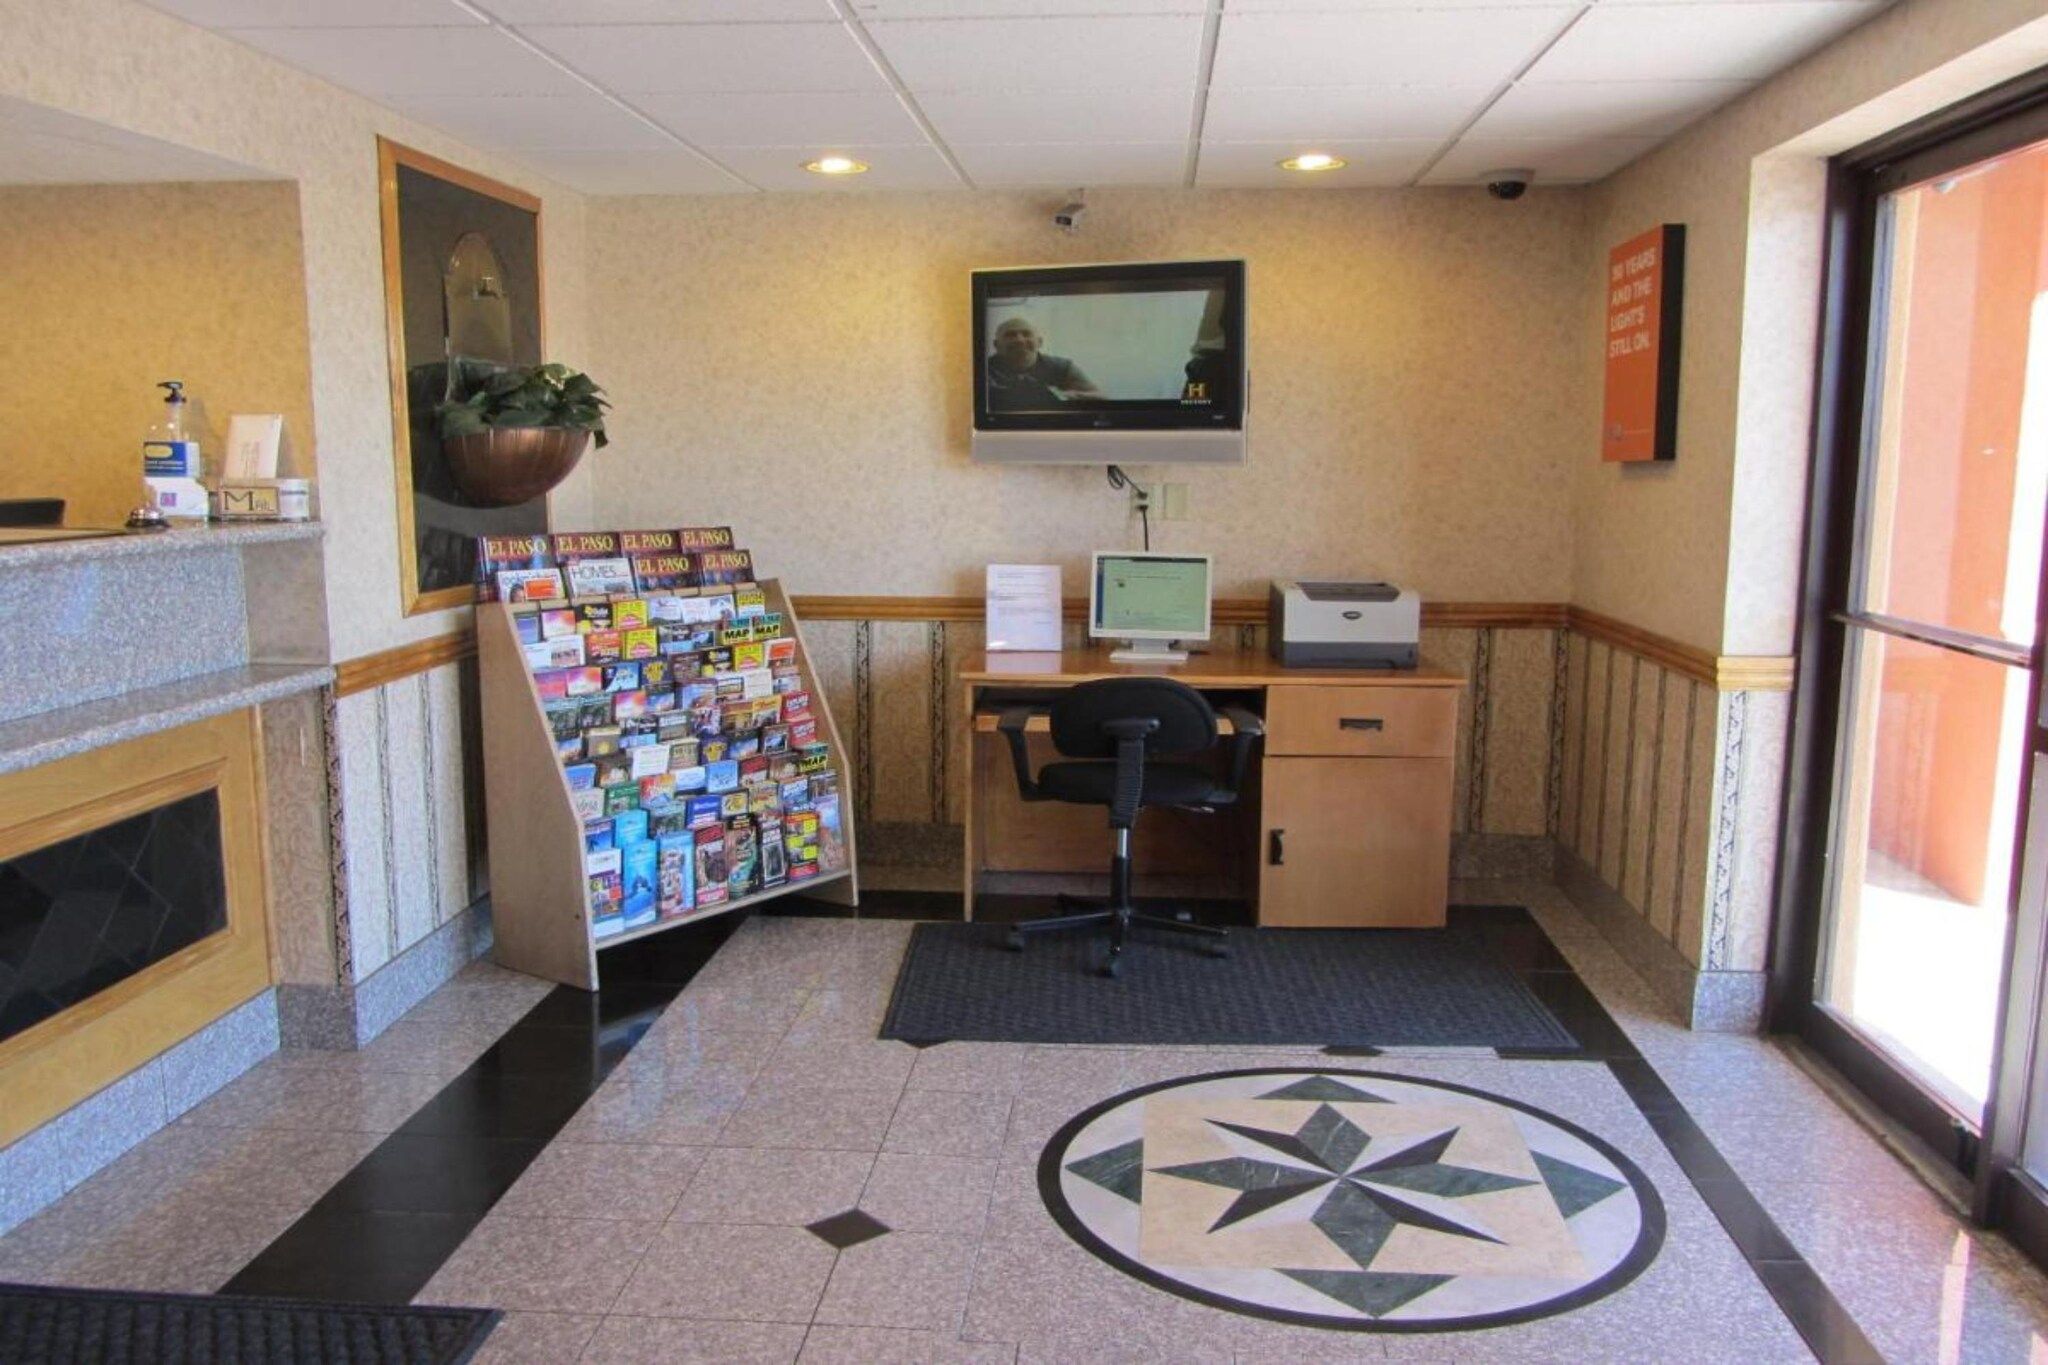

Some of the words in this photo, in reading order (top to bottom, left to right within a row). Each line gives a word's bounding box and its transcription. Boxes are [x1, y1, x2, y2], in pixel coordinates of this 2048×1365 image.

[1188, 383, 1206, 398] H
[559, 537, 577, 552] EL
[580, 535, 614, 552] PASO
[623, 534, 640, 549] EL
[642, 533, 672, 548] PASO
[682, 530, 698, 545] EL
[700, 529, 729, 545] PASO
[488, 540, 506, 556] EL
[509, 537, 547, 555] PASO
[637, 558, 659, 573] EL
[661, 557, 689, 572] PASO
[704, 554, 720, 569] EL
[721, 552, 748, 568] PASO
[571, 565, 617, 579] HOMES
[725, 629, 750, 640] MAP
[755, 624, 779, 634] MAP
